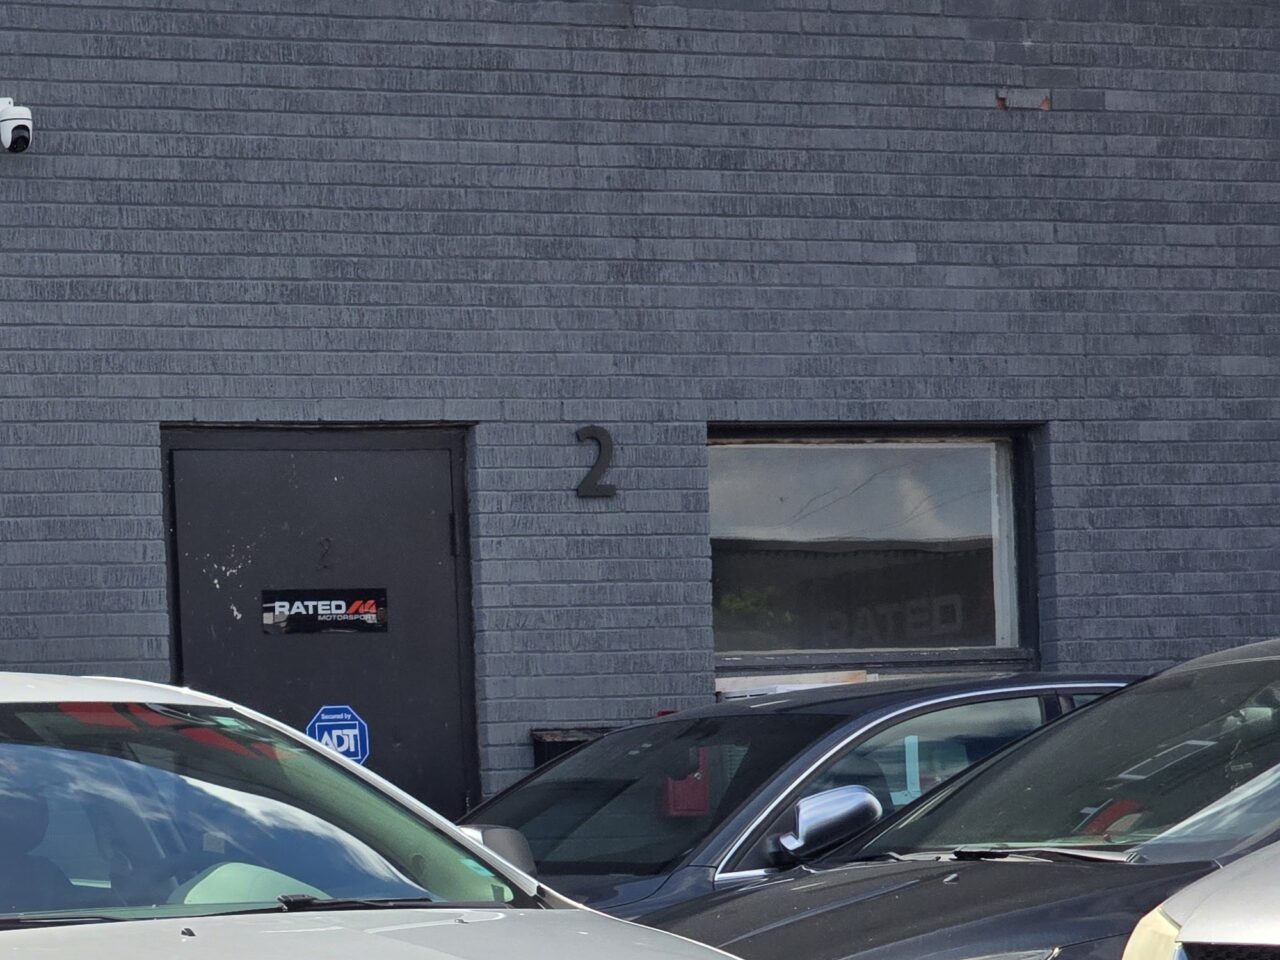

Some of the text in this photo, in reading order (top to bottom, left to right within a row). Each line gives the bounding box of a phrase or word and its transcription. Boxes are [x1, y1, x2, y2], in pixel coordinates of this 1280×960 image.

[576, 425, 616, 497] 2
[274, 600, 346, 615] RATED
[344, 712, 351, 720] by
[320, 728, 358, 752] ADT
